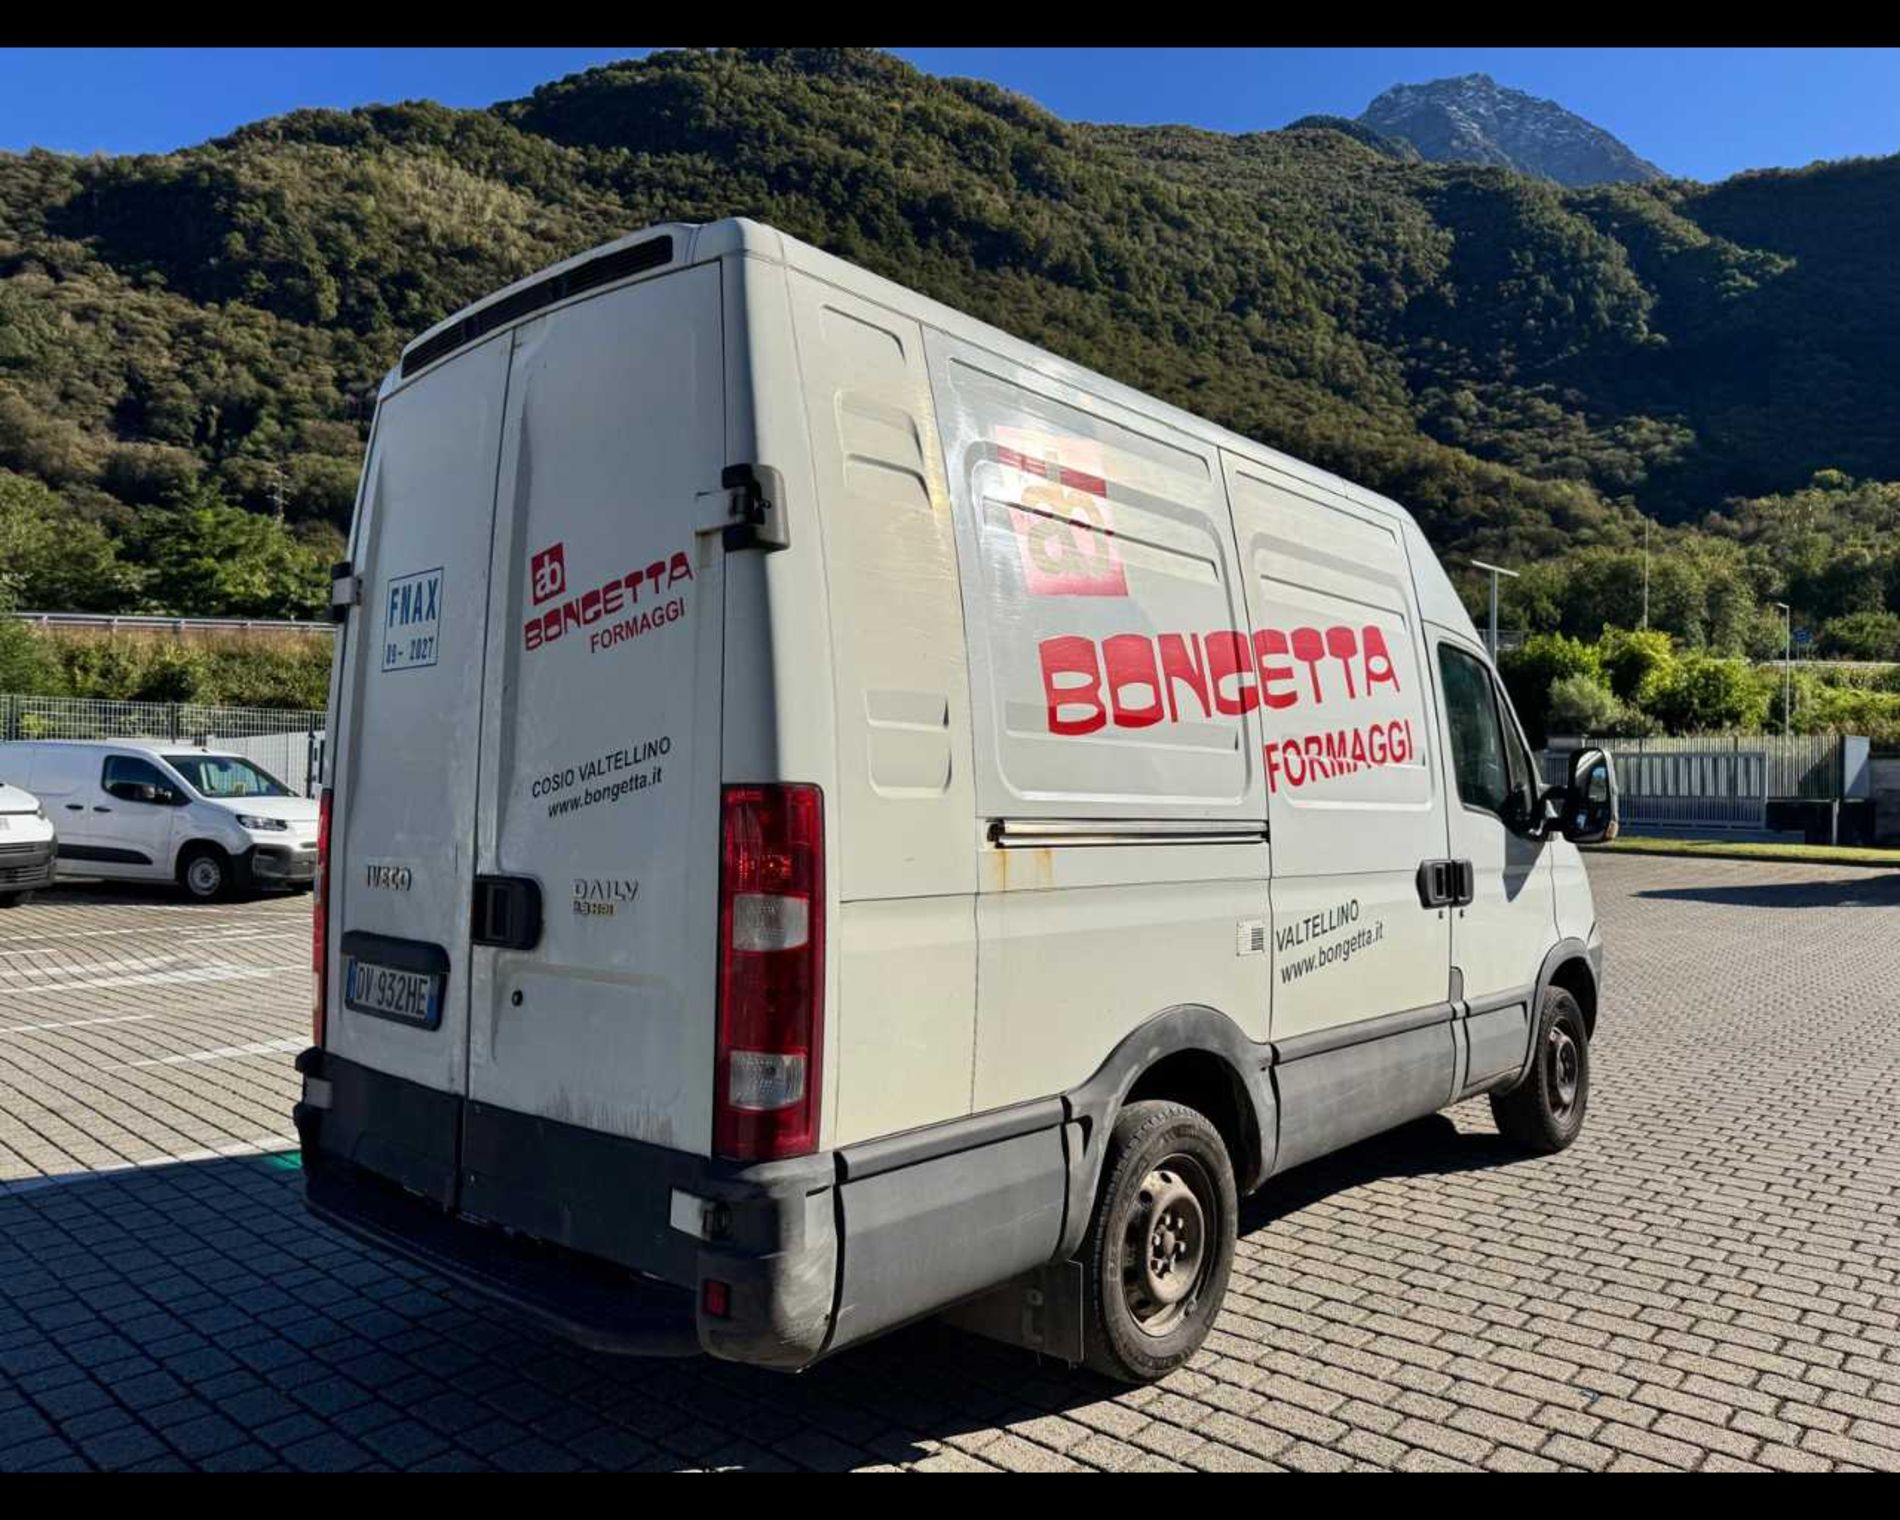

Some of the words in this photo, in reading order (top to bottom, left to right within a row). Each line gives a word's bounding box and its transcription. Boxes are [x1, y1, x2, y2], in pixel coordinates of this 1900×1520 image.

[388, 578, 439, 628] FNAX
[523, 551, 693, 651] BONGETTA
[589, 597, 686, 654] FORMAGGI
[1038, 625, 1401, 736] BONGETTA
[531, 768, 575, 798] COSIO
[577, 735, 671, 782] VALTELLINO
[1264, 719, 1414, 794] FORMAGGI
[547, 766, 662, 818] www.bongetta.it
[367, 864, 412, 891] IVECO
[571, 877, 640, 902] DAILY
[1275, 899, 1360, 952] VALTELLINO
[1280, 921, 1383, 984] www.bongetta.it
